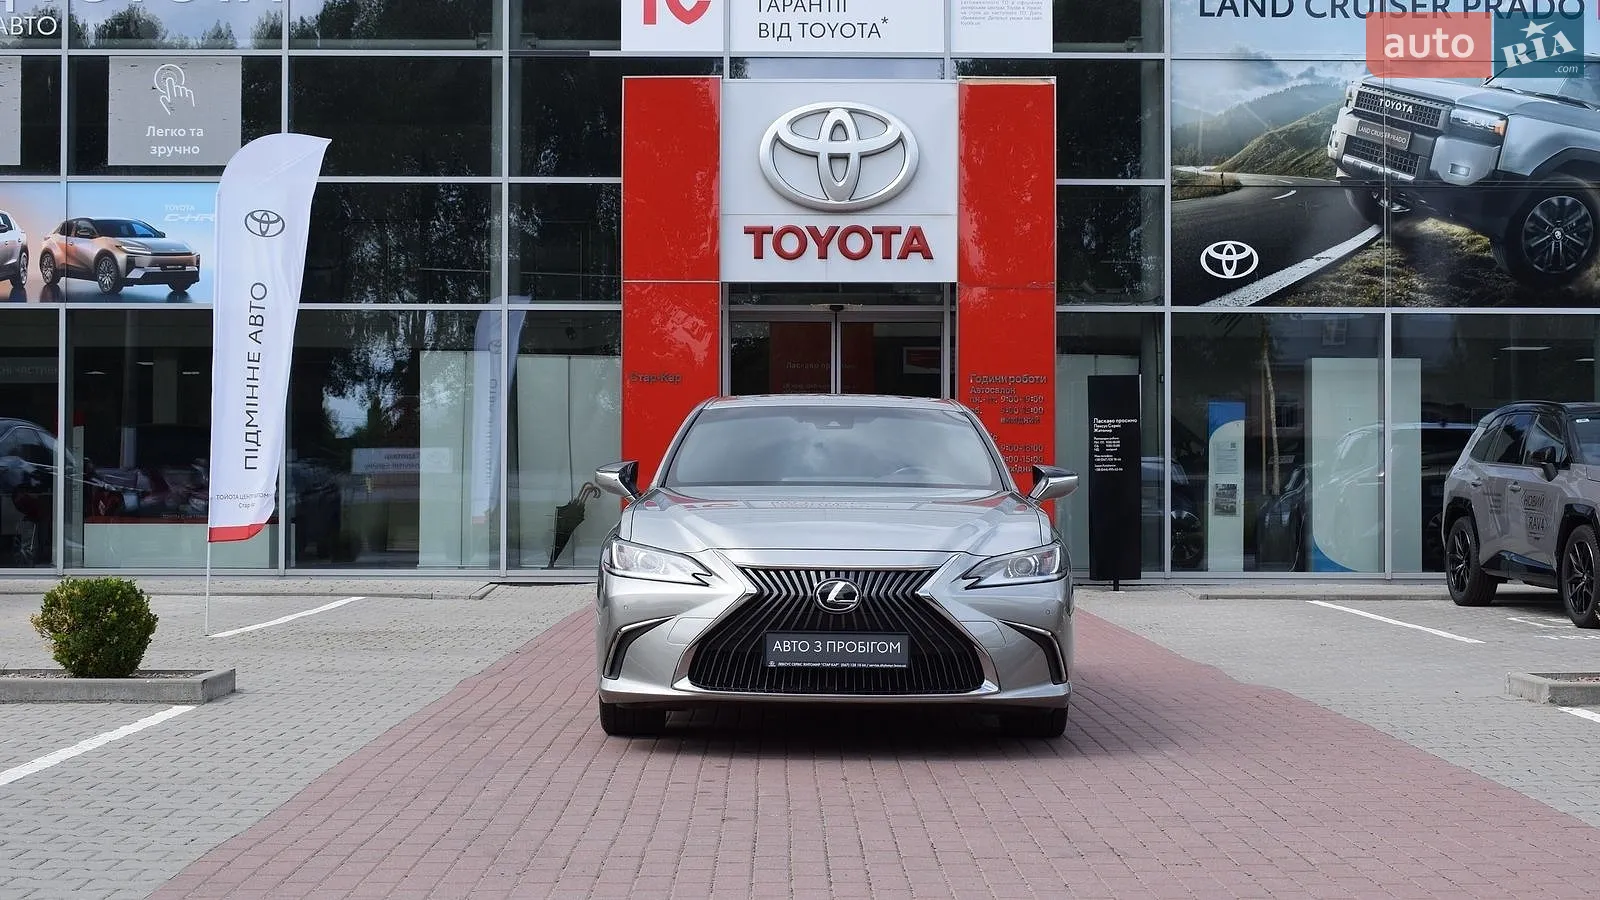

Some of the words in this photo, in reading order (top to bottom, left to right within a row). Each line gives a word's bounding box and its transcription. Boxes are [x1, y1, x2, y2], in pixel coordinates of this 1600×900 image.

[1199, 0, 1295, 18] LAND
[1304, 0, 1453, 19] CRUISER
[1463, 0, 1585, 20] PRADO
[758, 22, 792, 41] ВІД
[1379, 98, 1413, 113] TOYOTA
[145, 125, 186, 137] Легко
[189, 128, 204, 137] та
[150, 145, 201, 158] зручно
[743, 225, 934, 261] TOYOTA
[249, 282, 267, 345] АВТО
[969, 373, 1008, 385] Години
[1008, 373, 1047, 386] роботи
[969, 385, 1016, 394] Автосалон
[245, 352, 261, 470] ПІДМІННЕ
[1528, 516, 1545, 531] RAV4
[772, 640, 810, 653] АВТО
[813, 640, 822, 653] З
[826, 641, 901, 654] ПРОБІГОМ
